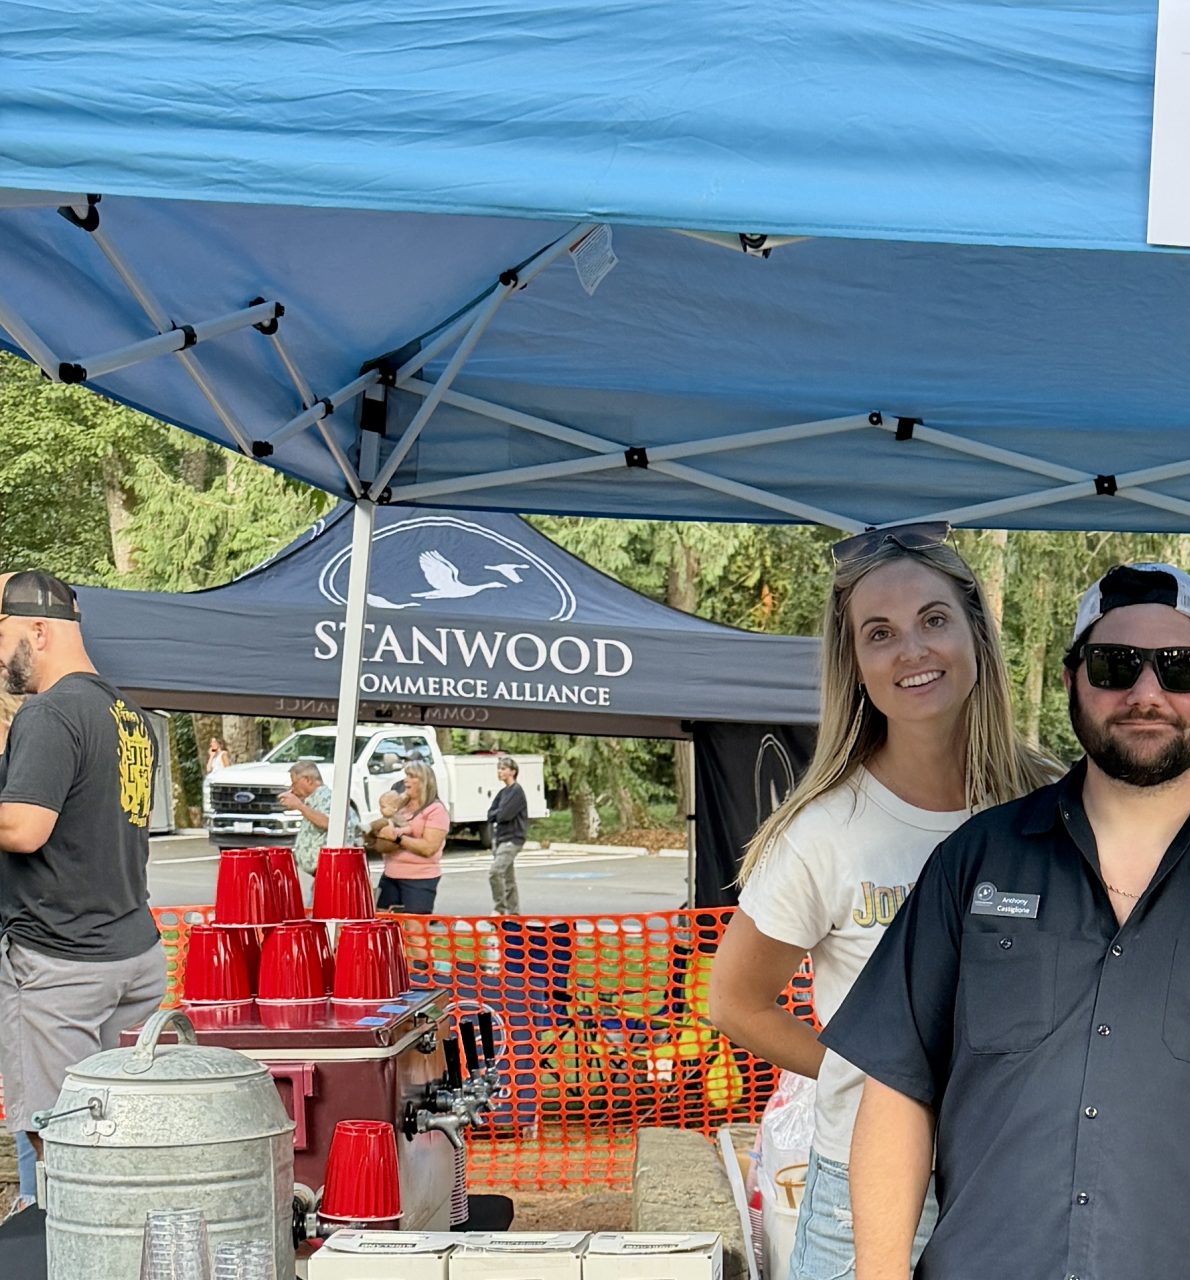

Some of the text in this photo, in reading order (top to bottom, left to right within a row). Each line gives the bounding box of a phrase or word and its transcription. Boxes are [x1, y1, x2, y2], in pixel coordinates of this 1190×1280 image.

[359, 673, 611, 707] OMMERCE ALLIANCE
[1002, 897, 1029, 906] Anthony
